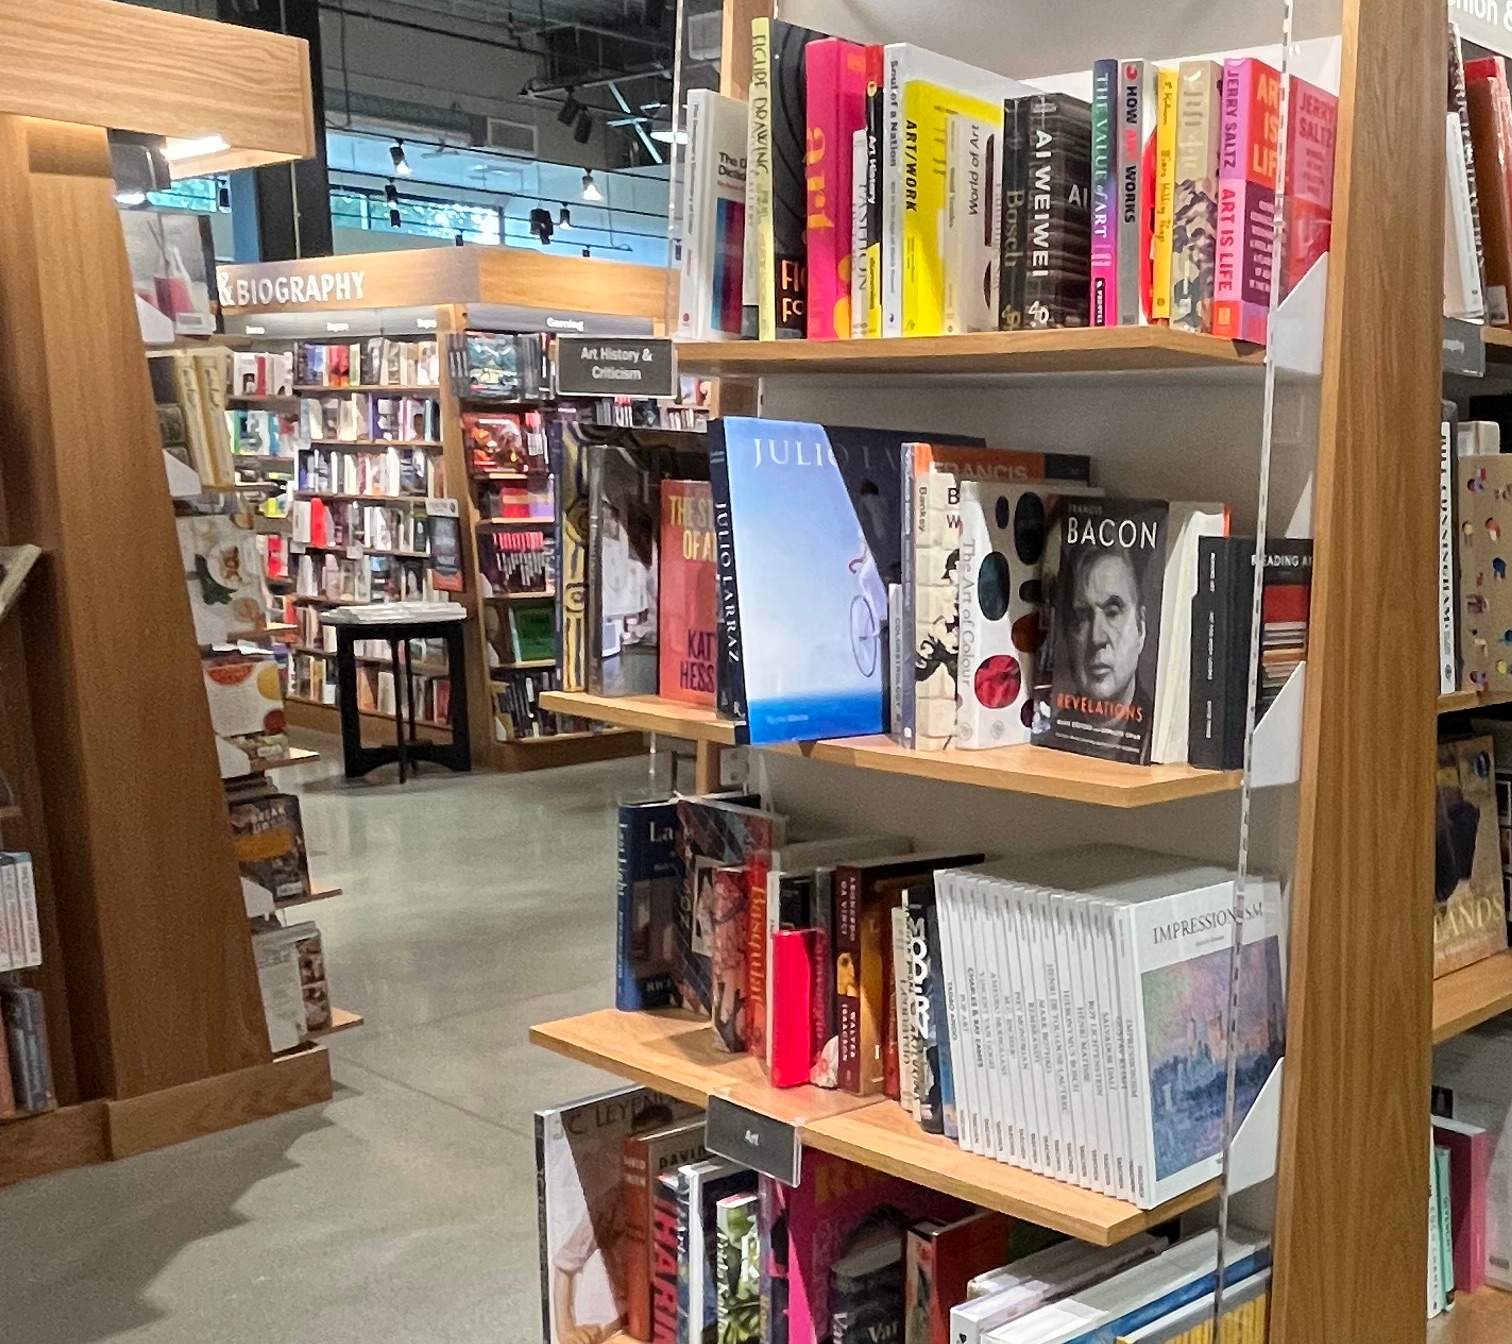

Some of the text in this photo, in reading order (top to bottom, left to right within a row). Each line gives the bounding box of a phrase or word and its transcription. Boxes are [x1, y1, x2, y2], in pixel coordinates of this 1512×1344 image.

[890, 60, 899, 91] Soul
[1095, 73, 1109, 113] THE
[1256, 72, 1280, 107] AR
[1125, 85, 1138, 125] HOW
[1224, 69, 1240, 169] JERRY SALTZ
[889, 122, 898, 167] Nation
[905, 119, 918, 213] ART/WORK
[1252, 143, 1278, 178] LIF
[806, 126, 836, 230] art
[866, 135, 878, 205] Art History
[967, 124, 980, 217] World of Art
[1031, 129, 1053, 278] AI WEIWEI
[1124, 165, 1137, 224] WORKS
[1003, 190, 1026, 268] Bosch
[1094, 199, 1109, 239] ART
[1217, 188, 1236, 292] ART IS LIFE
[238, 270, 365, 307] BIOGRAPHY
[545, 316, 585, 333] Gaming
[580, 347, 654, 364] Art History &
[591, 365, 642, 381] Criticism
[1066, 516, 1159, 550] BACON
[715, 502, 740, 663] JULIO LARRAZ
[961, 538, 976, 688] The Art of Colour
[687, 628, 715, 659] KAT
[679, 660, 715, 693] HESS
[1055, 692, 1144, 723] REVELATIONS
[749, 884, 767, 1005] Basquiat
[1151, 901, 1264, 947] IMPRESSIONSM
[967, 967, 978, 1009] CHARLES
[841, 1003, 849, 1062] ISAACSON
[848, 1011, 857, 1059] WALTER
[743, 1129, 761, 1146] Art
